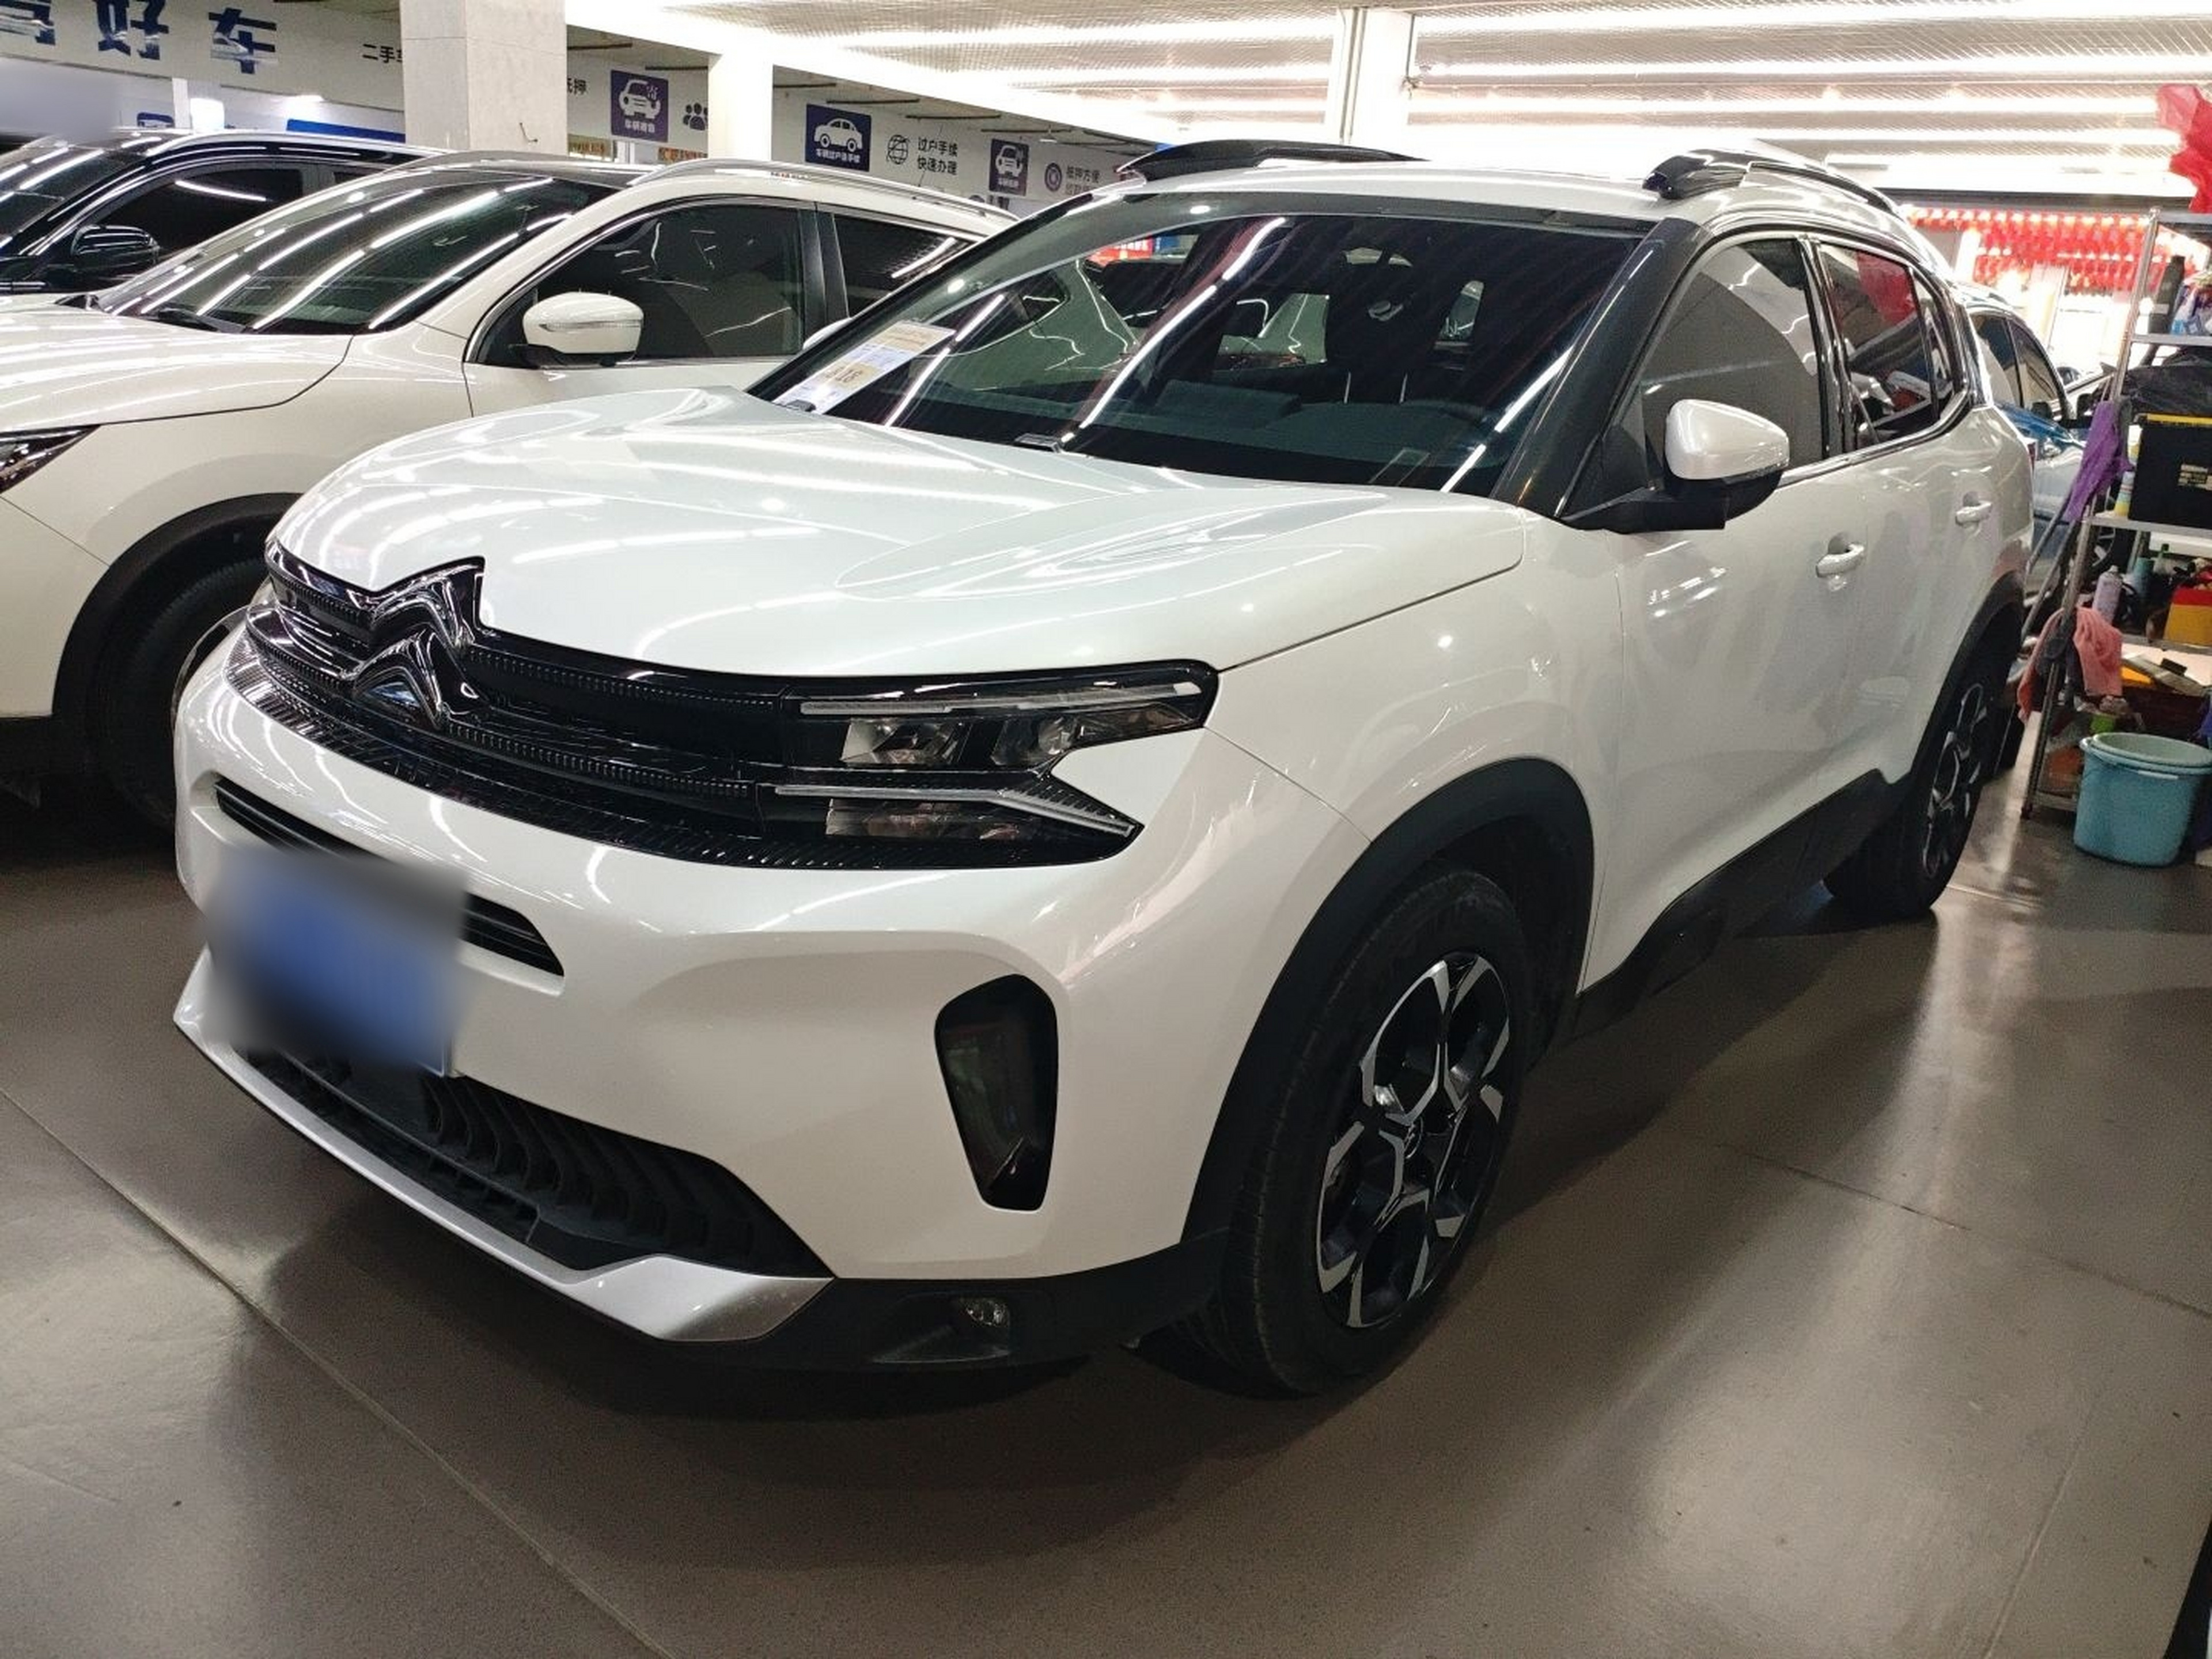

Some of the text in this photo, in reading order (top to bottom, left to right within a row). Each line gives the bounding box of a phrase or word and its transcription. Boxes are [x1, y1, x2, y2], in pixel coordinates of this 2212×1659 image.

[918, 137, 958, 157] 过户手续
[917, 156, 958, 175] 快速办理
